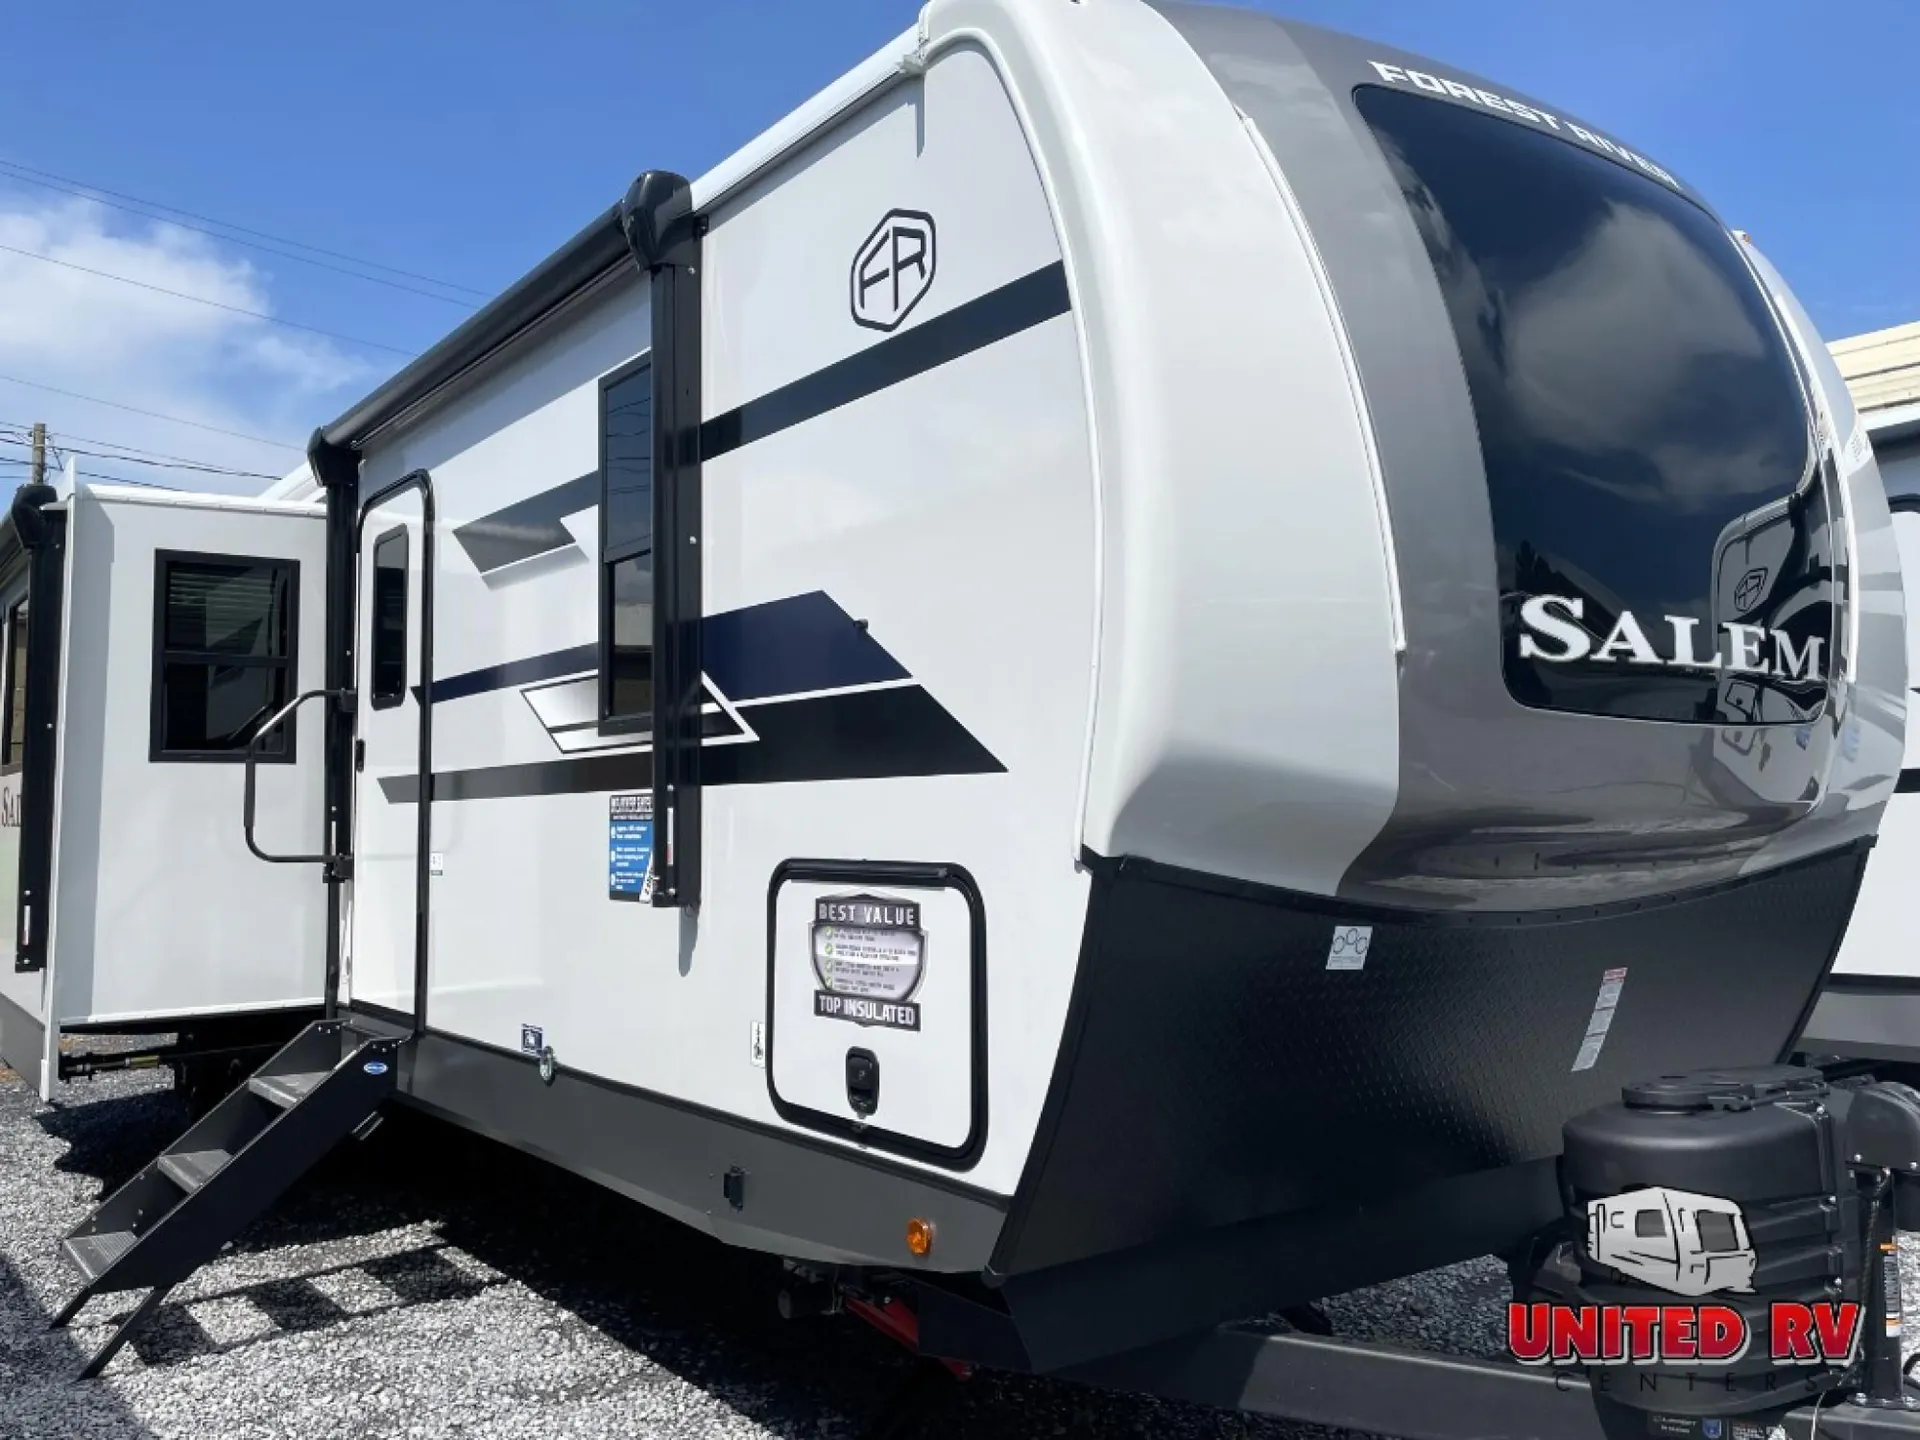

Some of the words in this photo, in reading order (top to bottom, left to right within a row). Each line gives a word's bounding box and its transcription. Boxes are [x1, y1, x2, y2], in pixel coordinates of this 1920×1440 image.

[1366, 59, 1560, 129] FOREST
[1563, 121, 1681, 192] RIVER
[1518, 594, 1825, 682] SALEM
[1, 785, 22, 827] SAL
[818, 903, 856, 922] BEST
[863, 905, 915, 926] VALUE
[818, 995, 841, 1014] TOP
[843, 998, 916, 1026] INSULATED
